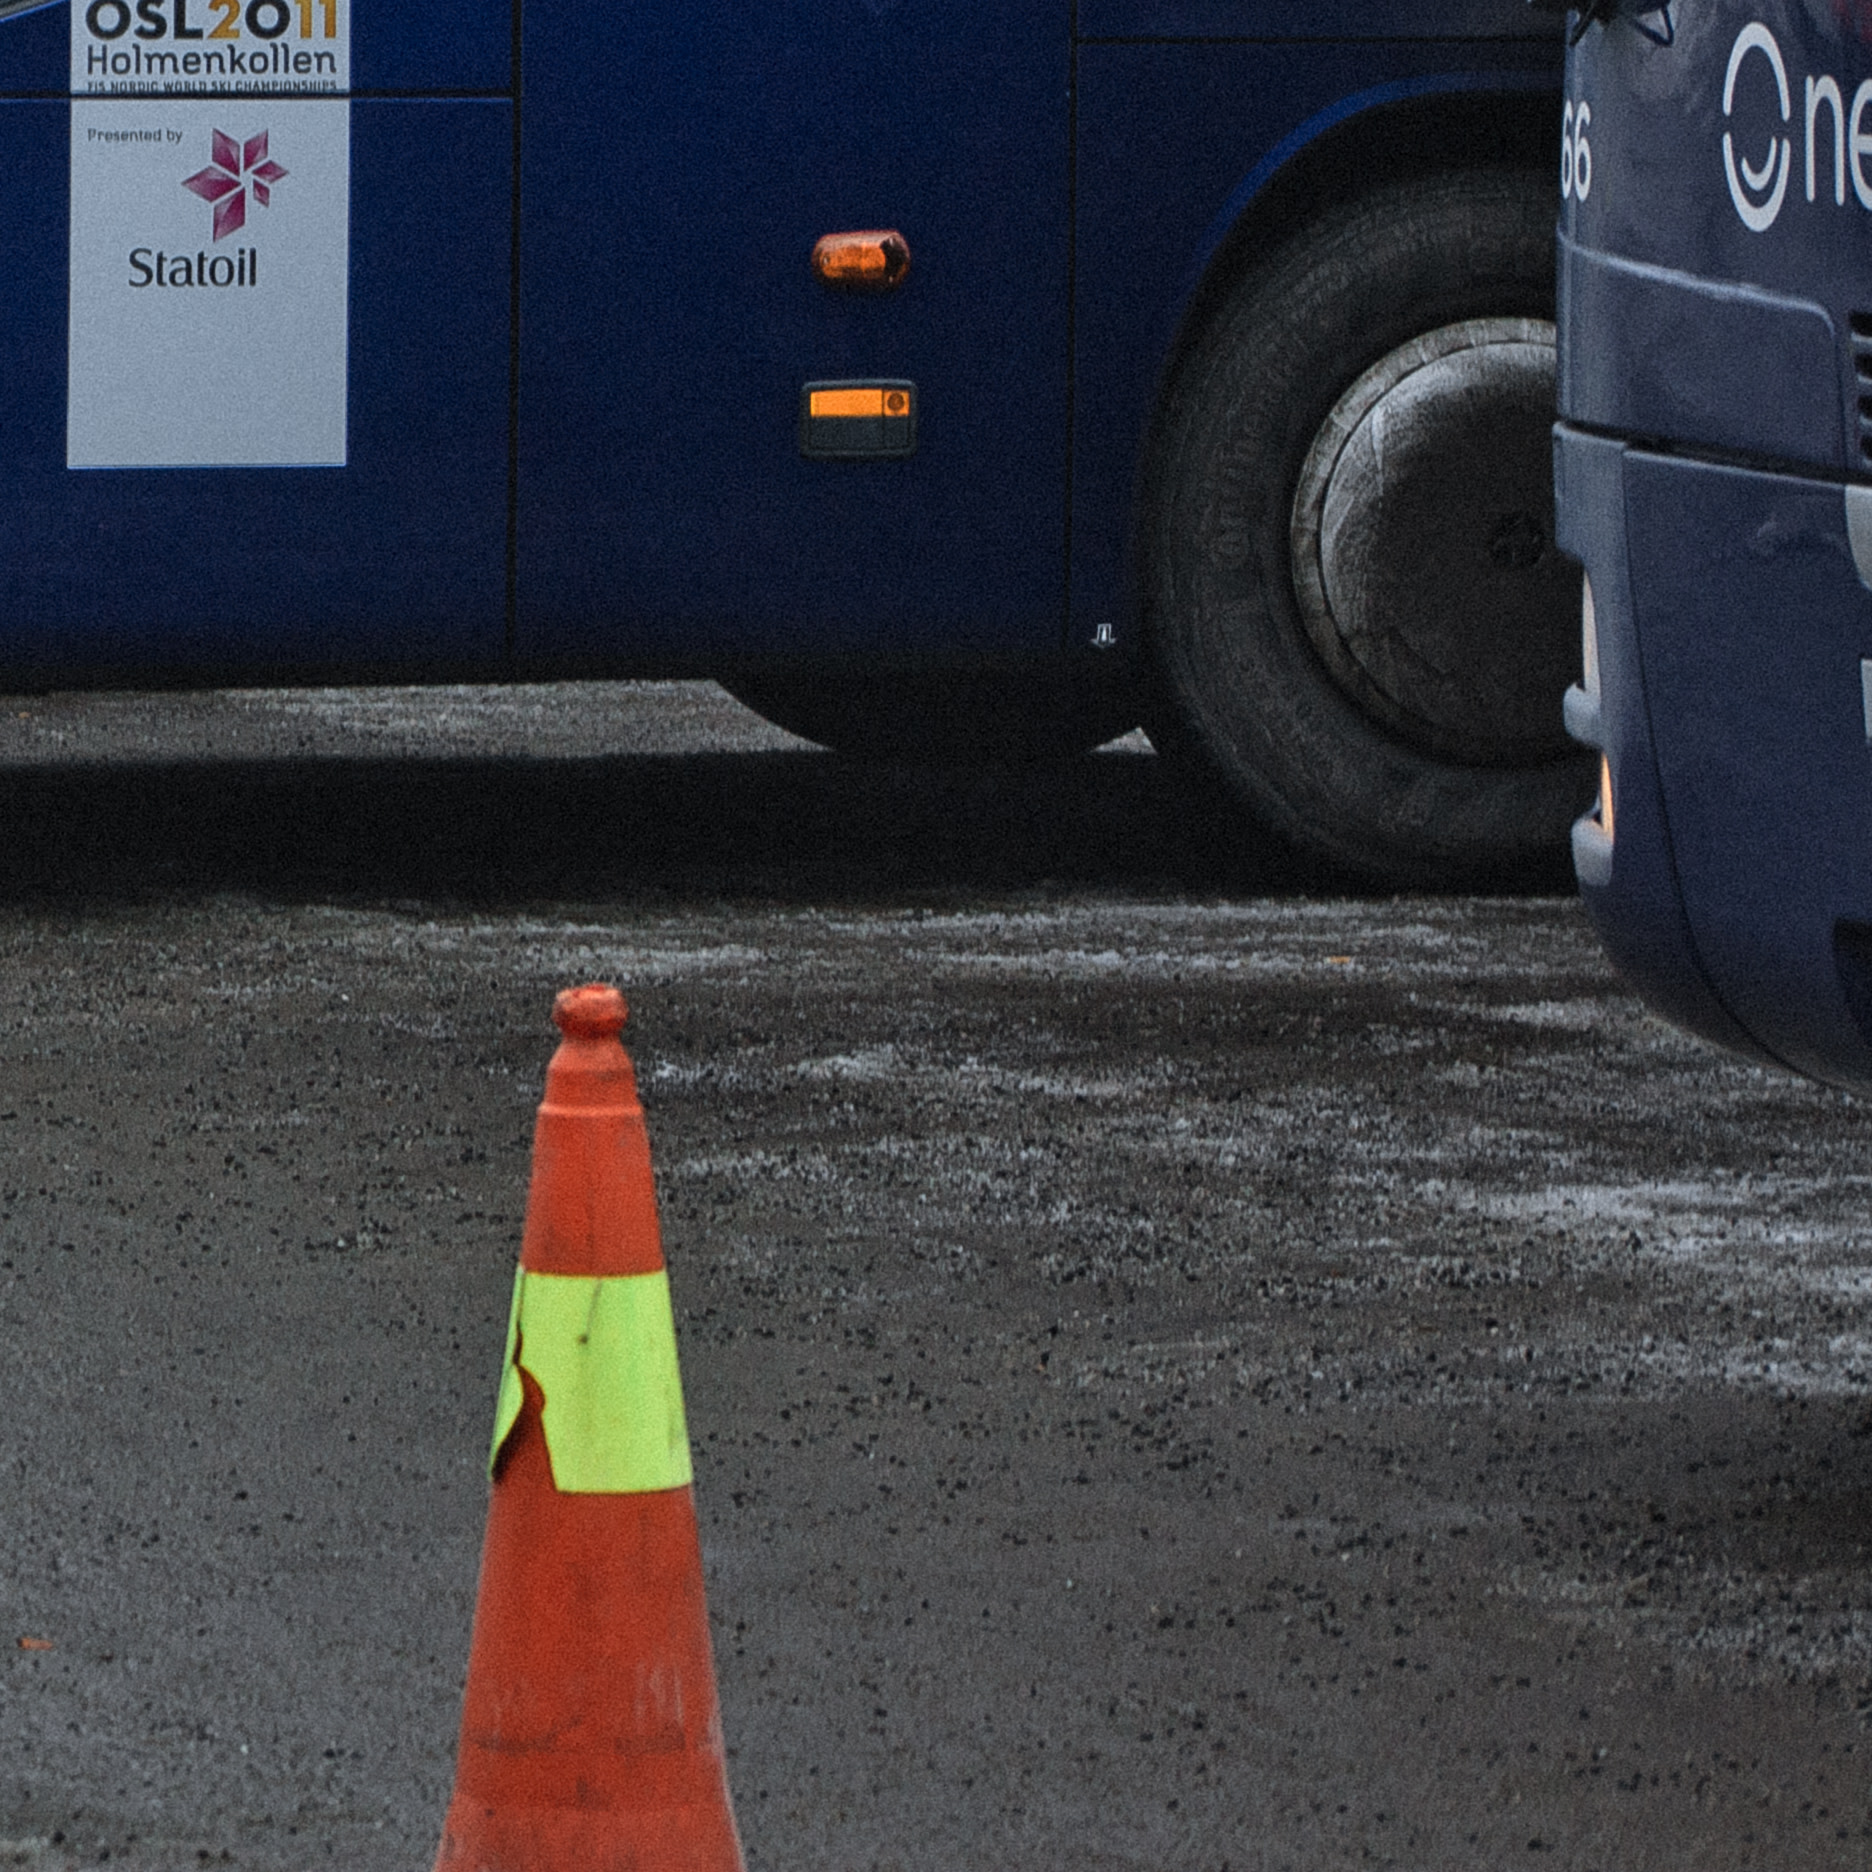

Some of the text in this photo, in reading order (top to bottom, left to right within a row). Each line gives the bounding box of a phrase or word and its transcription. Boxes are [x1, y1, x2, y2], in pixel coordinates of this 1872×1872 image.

[87, 42, 337, 75] Holmenkollen
[88, 80, 338, 91] FIS NORDIC WORLD SKI CHAMPIONSHIPS
[88, 128, 183, 144] Presented by
[1561, 99, 1592, 203] 66
[128, 246, 258, 288] Statoil
